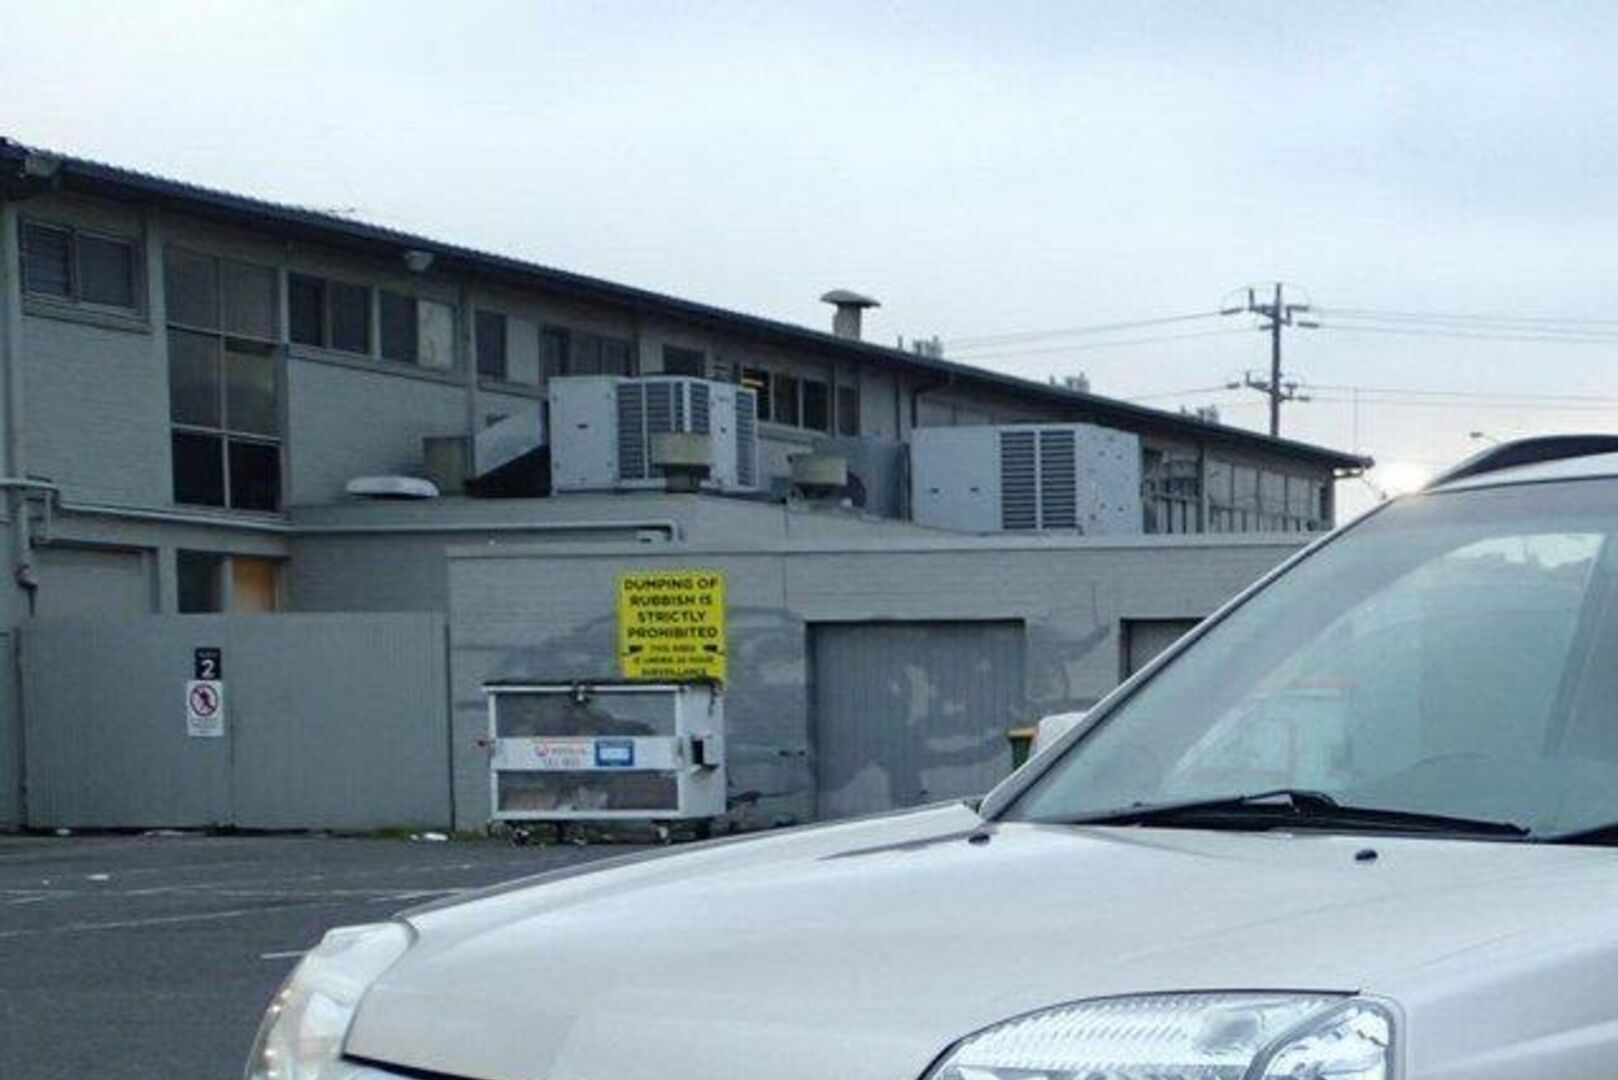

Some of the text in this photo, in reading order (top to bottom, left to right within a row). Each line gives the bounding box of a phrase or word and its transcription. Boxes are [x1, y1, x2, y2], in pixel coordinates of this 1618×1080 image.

[624, 578, 718, 590] DUMPING OF
[630, 595, 712, 606] RUBBISH IS
[637, 611, 706, 622] STRICTLY
[628, 626, 718, 638] PROHIBITED
[201, 659, 215, 679] 2
